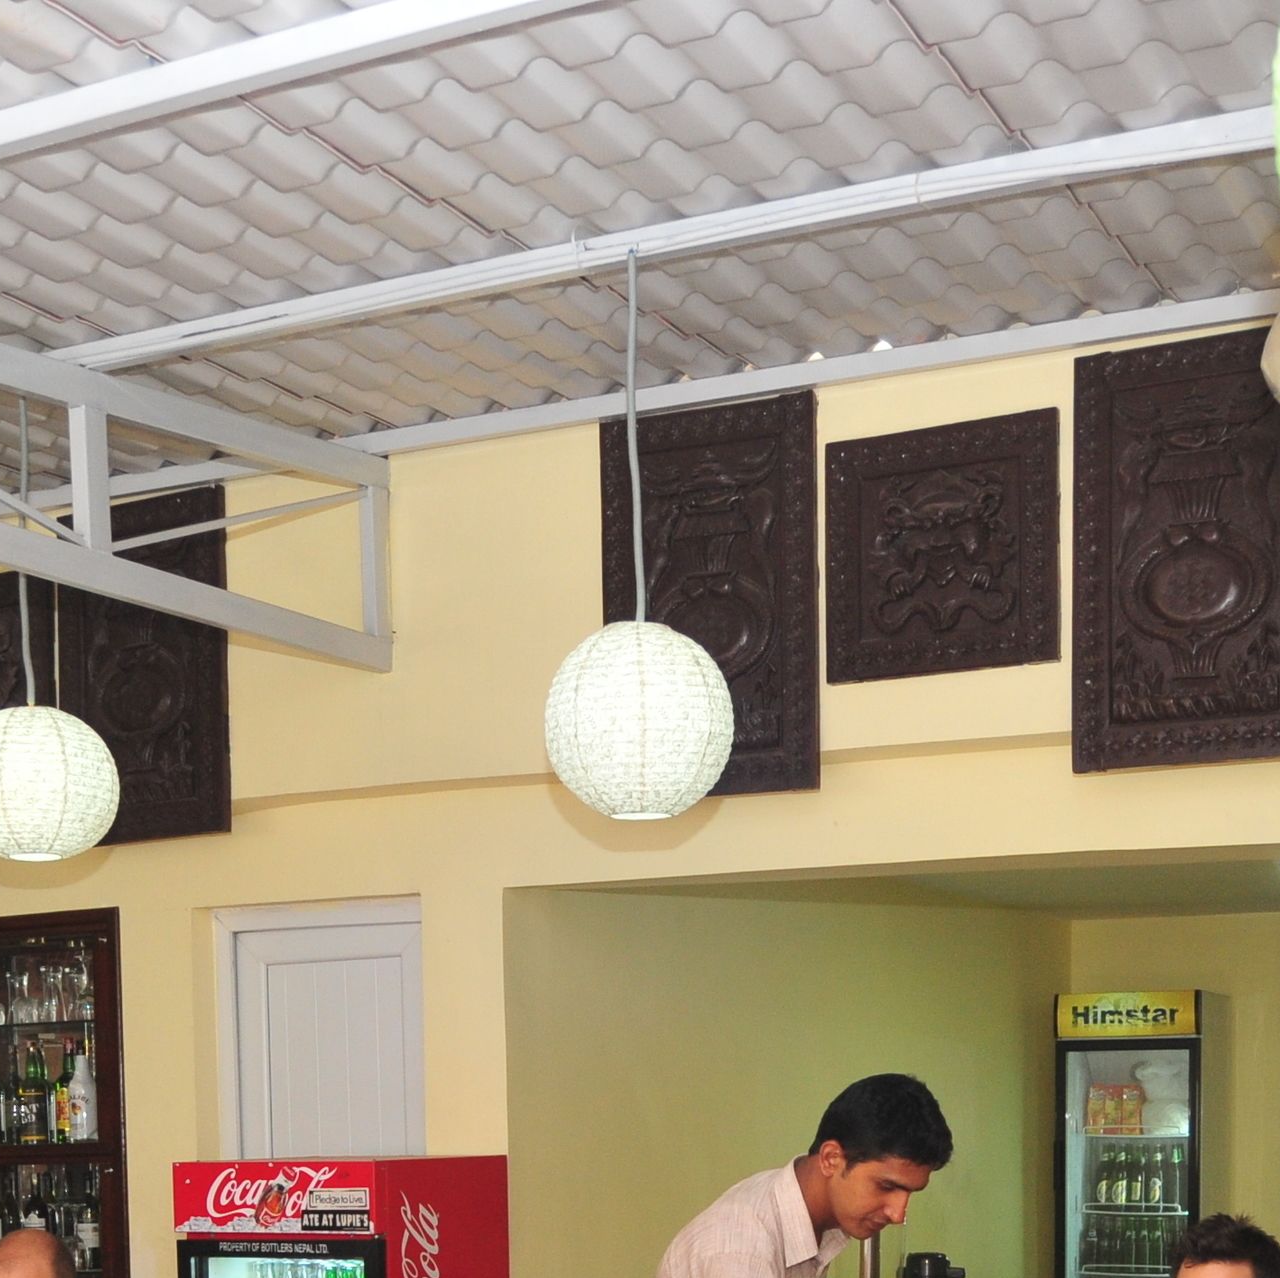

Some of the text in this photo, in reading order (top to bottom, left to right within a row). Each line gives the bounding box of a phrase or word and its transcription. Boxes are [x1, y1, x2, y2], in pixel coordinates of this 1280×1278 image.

[1072, 1004, 1179, 1026] Himstar
[302, 1213, 368, 1227] ATE AT LUPIE'S
[219, 1242, 329, 1254] PROPERTY OF BOTTLERS NEPAL LTD.
